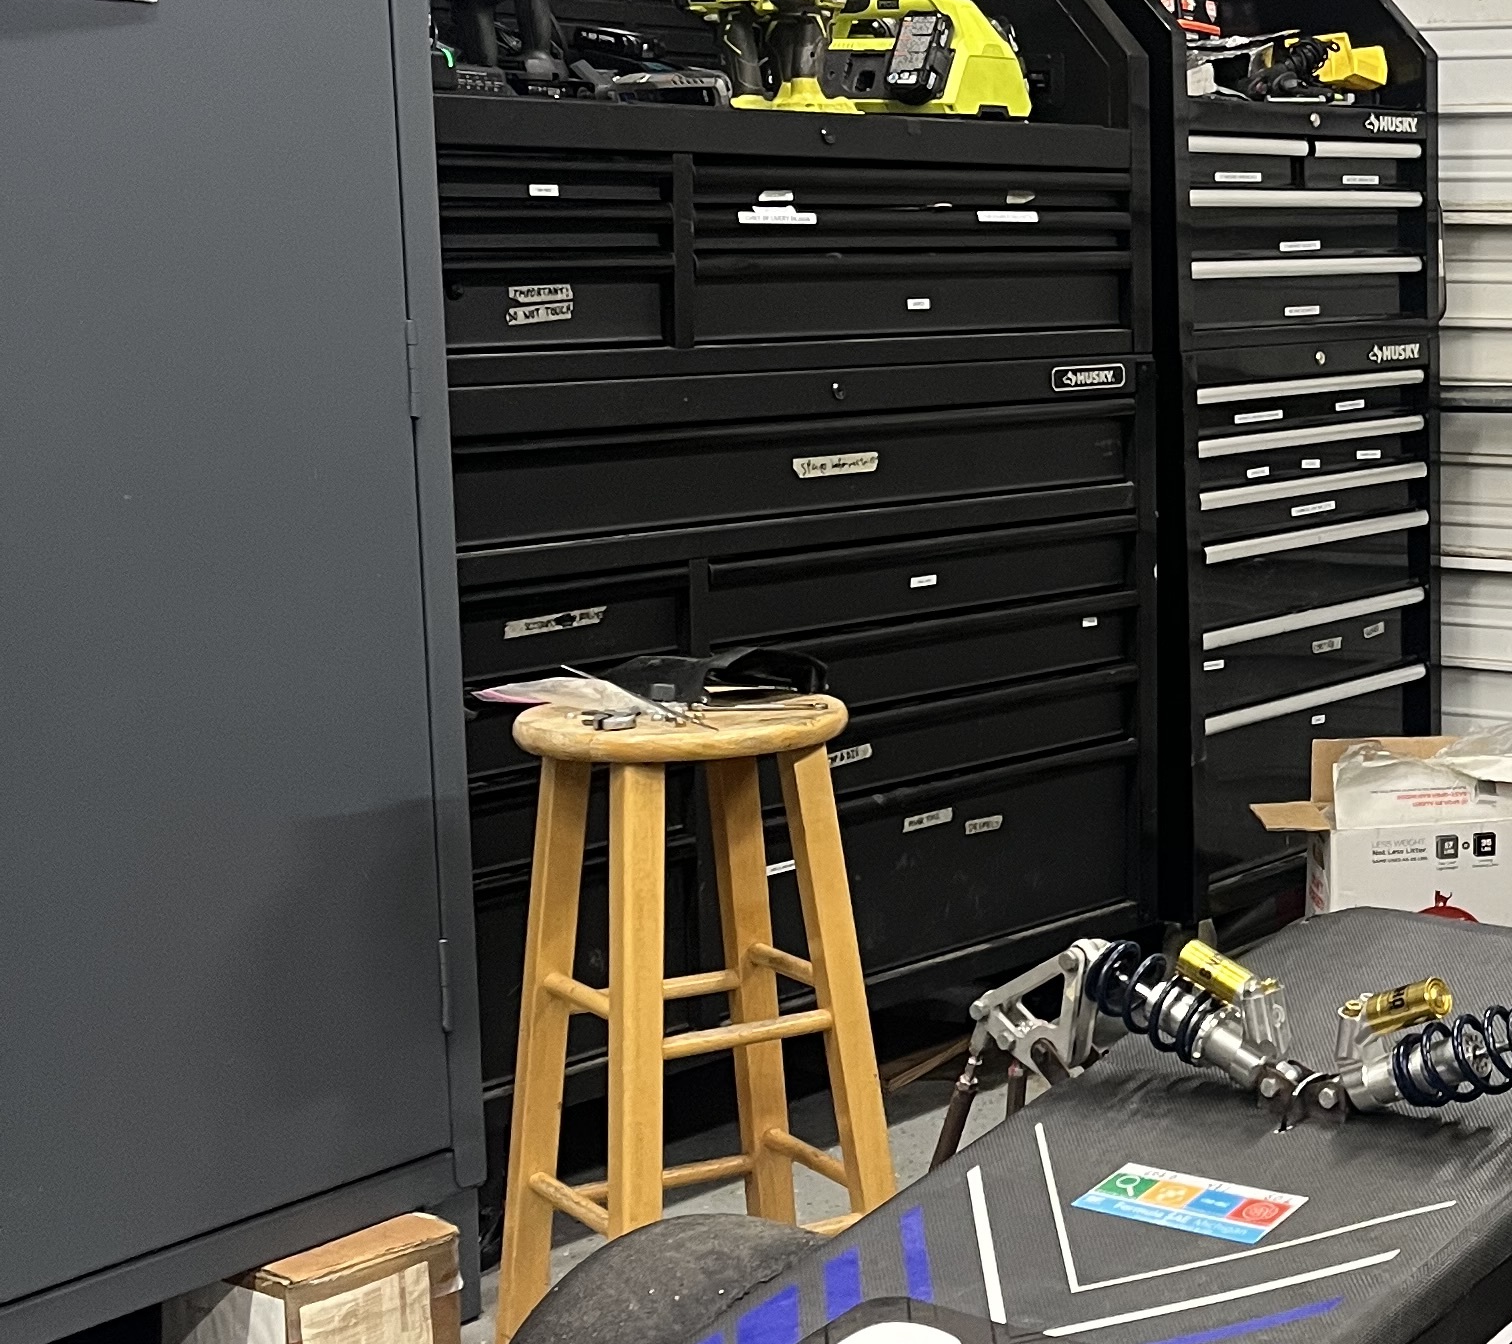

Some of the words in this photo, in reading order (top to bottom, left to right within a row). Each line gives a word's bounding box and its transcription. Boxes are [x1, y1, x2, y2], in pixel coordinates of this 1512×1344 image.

[1379, 115, 1419, 133] HUSKY
[523, 307, 541, 320] NOT
[545, 303, 571, 317] TOUCH
[1381, 343, 1420, 361] HUSKY
[1076, 369, 1115, 385] HUSKY
[1394, 837, 1426, 848] WEIGHT
[1112, 1200, 1165, 1219] Formula
[1193, 1217, 1249, 1236] Michigan
